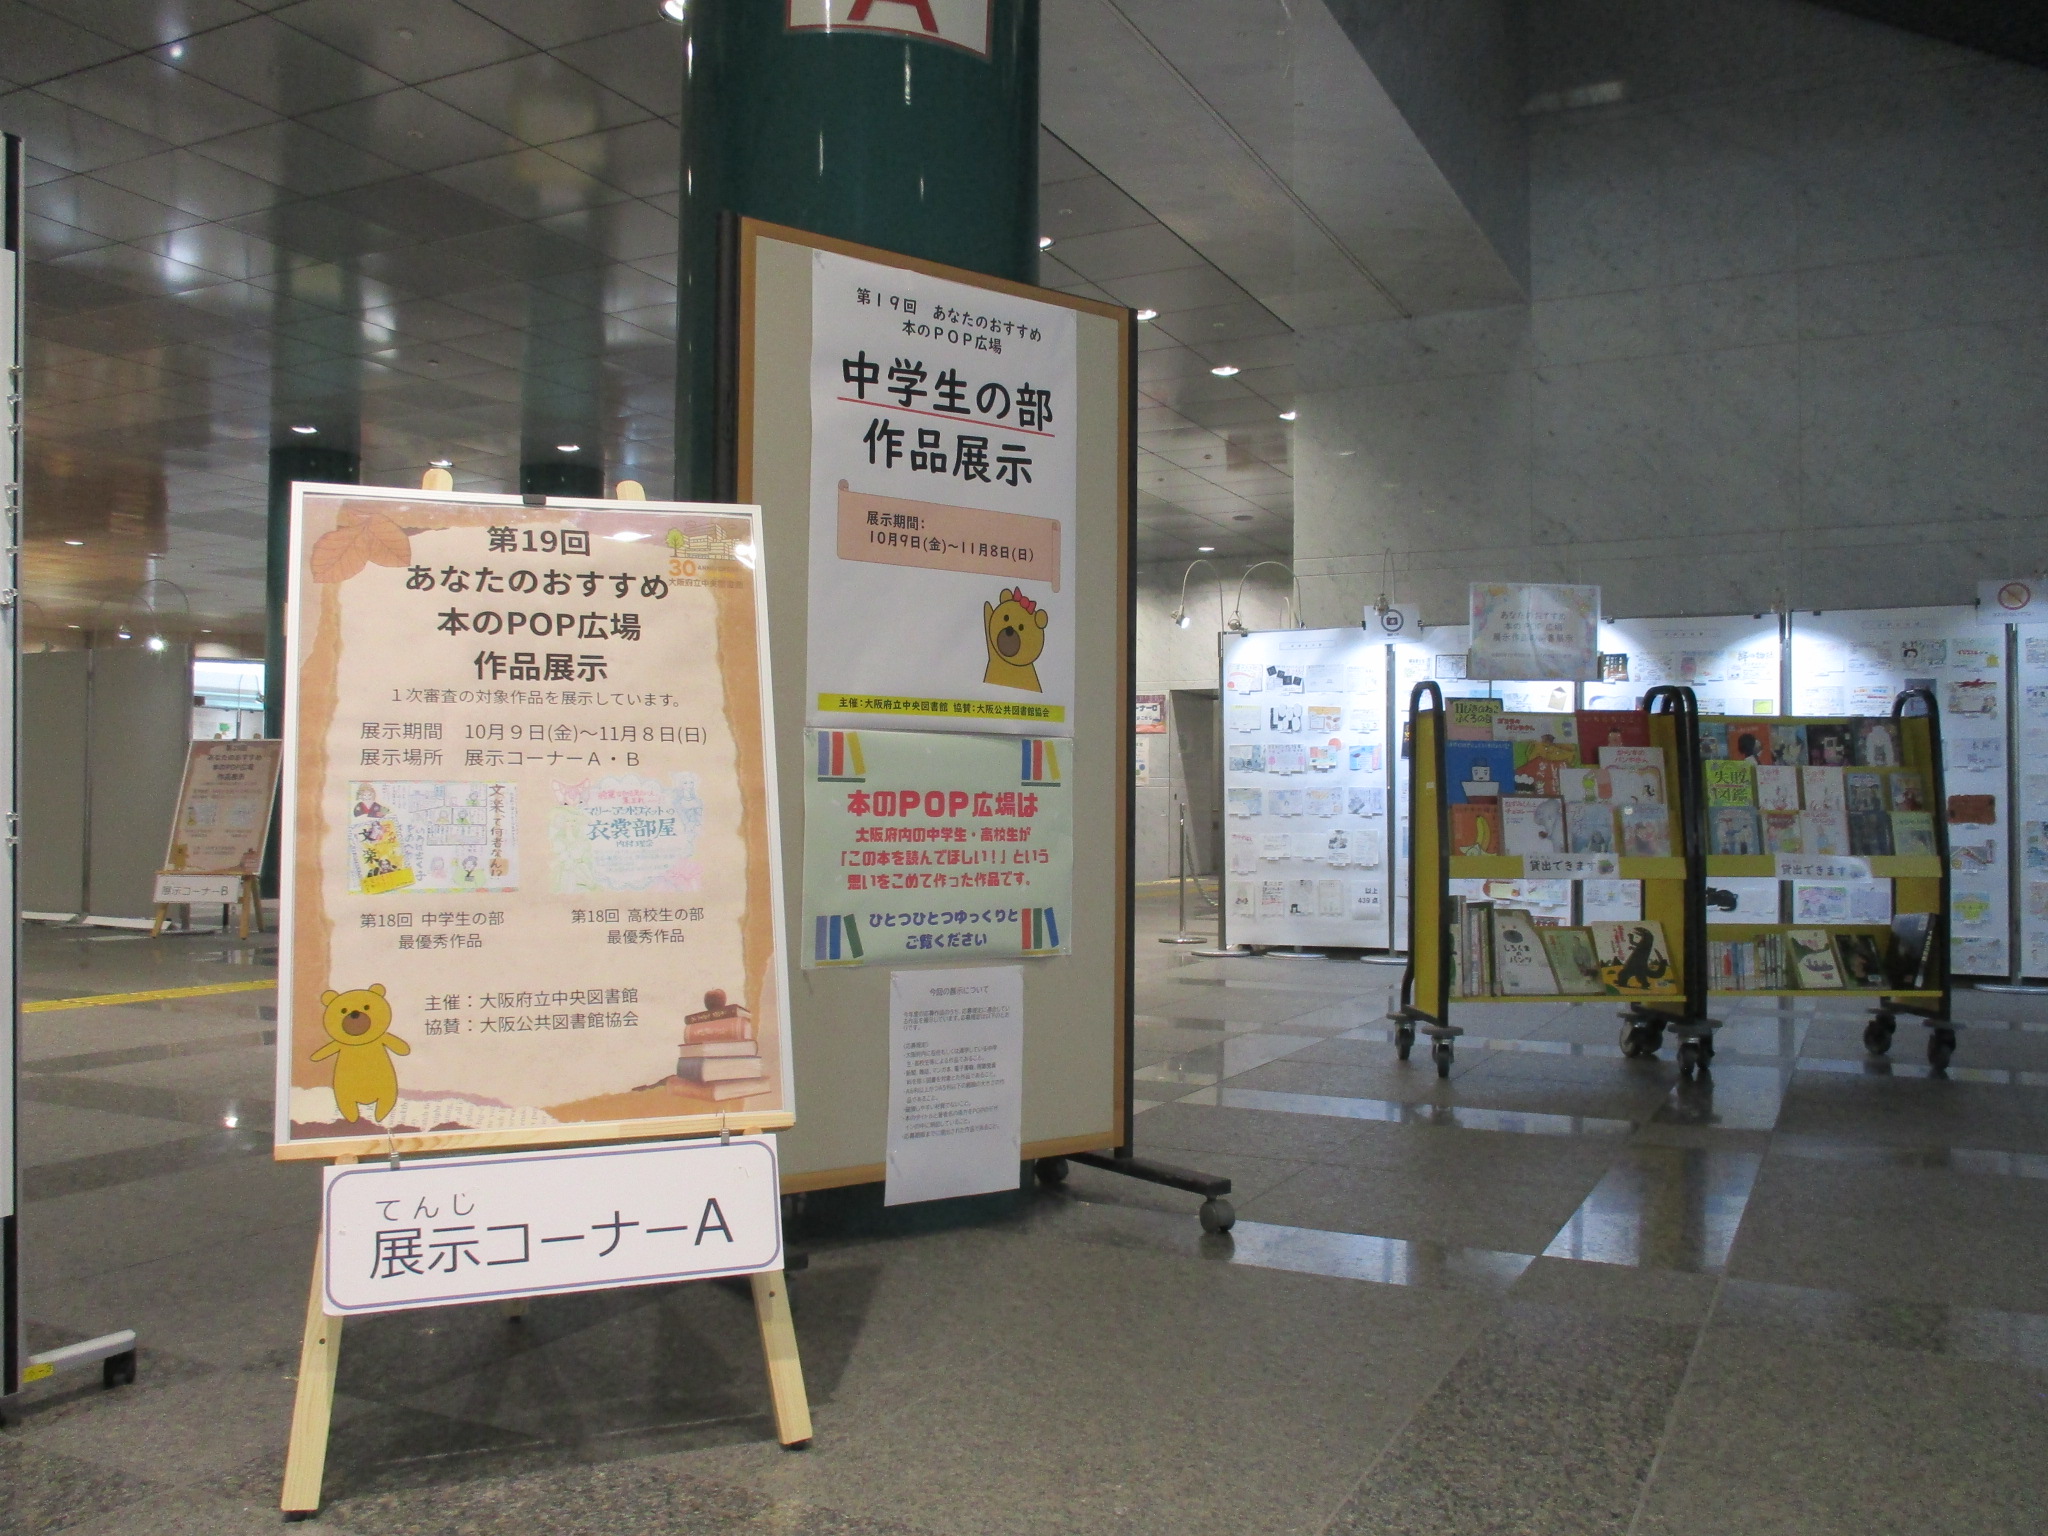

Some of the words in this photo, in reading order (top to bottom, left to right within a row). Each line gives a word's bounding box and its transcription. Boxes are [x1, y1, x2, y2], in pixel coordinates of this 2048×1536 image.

[856, 286, 917, 315] 第19回
[933, 304, 1042, 343] あなたのおすすめ
[901, 319, 1002, 355] 本のPOP広場
[842, 350, 1054, 431] 中学生の部
[862, 417, 1033, 487] 作品展示
[486, 525, 591, 556] 第19回
[405, 563, 670, 601] あなたのおすすめ
[437, 607, 642, 642] 本のPOP広場
[474, 649, 609, 682] 作品展示
[391, 687, 682, 709] 1次審査の対象作品を展示しています。
[360, 721, 443, 742] 展示期間
[360, 747, 443, 767] 展示場所
[847, 790, 1039, 818] 本のPOP広場は
[855, 827, 1031, 843] 大阪府内の中学生・高校生が
[1529, 860, 1596, 872] 貸出できます
[847, 872, 1031, 890] 思いをこめて作った作品です。
[360, 911, 413, 929] 第18回
[421, 910, 505, 928] 中学生の部
[571, 907, 620, 925] 第18回
[627, 906, 705, 924] 高校生の部
[869, 909, 1019, 928] ひとつひとつゆっくりと
[398, 932, 483, 950] 最優秀作品
[606, 928, 685, 945] 最優秀作品
[905, 932, 987, 950] ご覧ください
[424, 987, 639, 1012] 主催：大阪府立中央図書館
[424, 1010, 639, 1036] 協賛：大阪公共図書館協会
[375, 1193, 475, 1222] てんじ
[369, 1197, 734, 1280] 展示コーナーA
